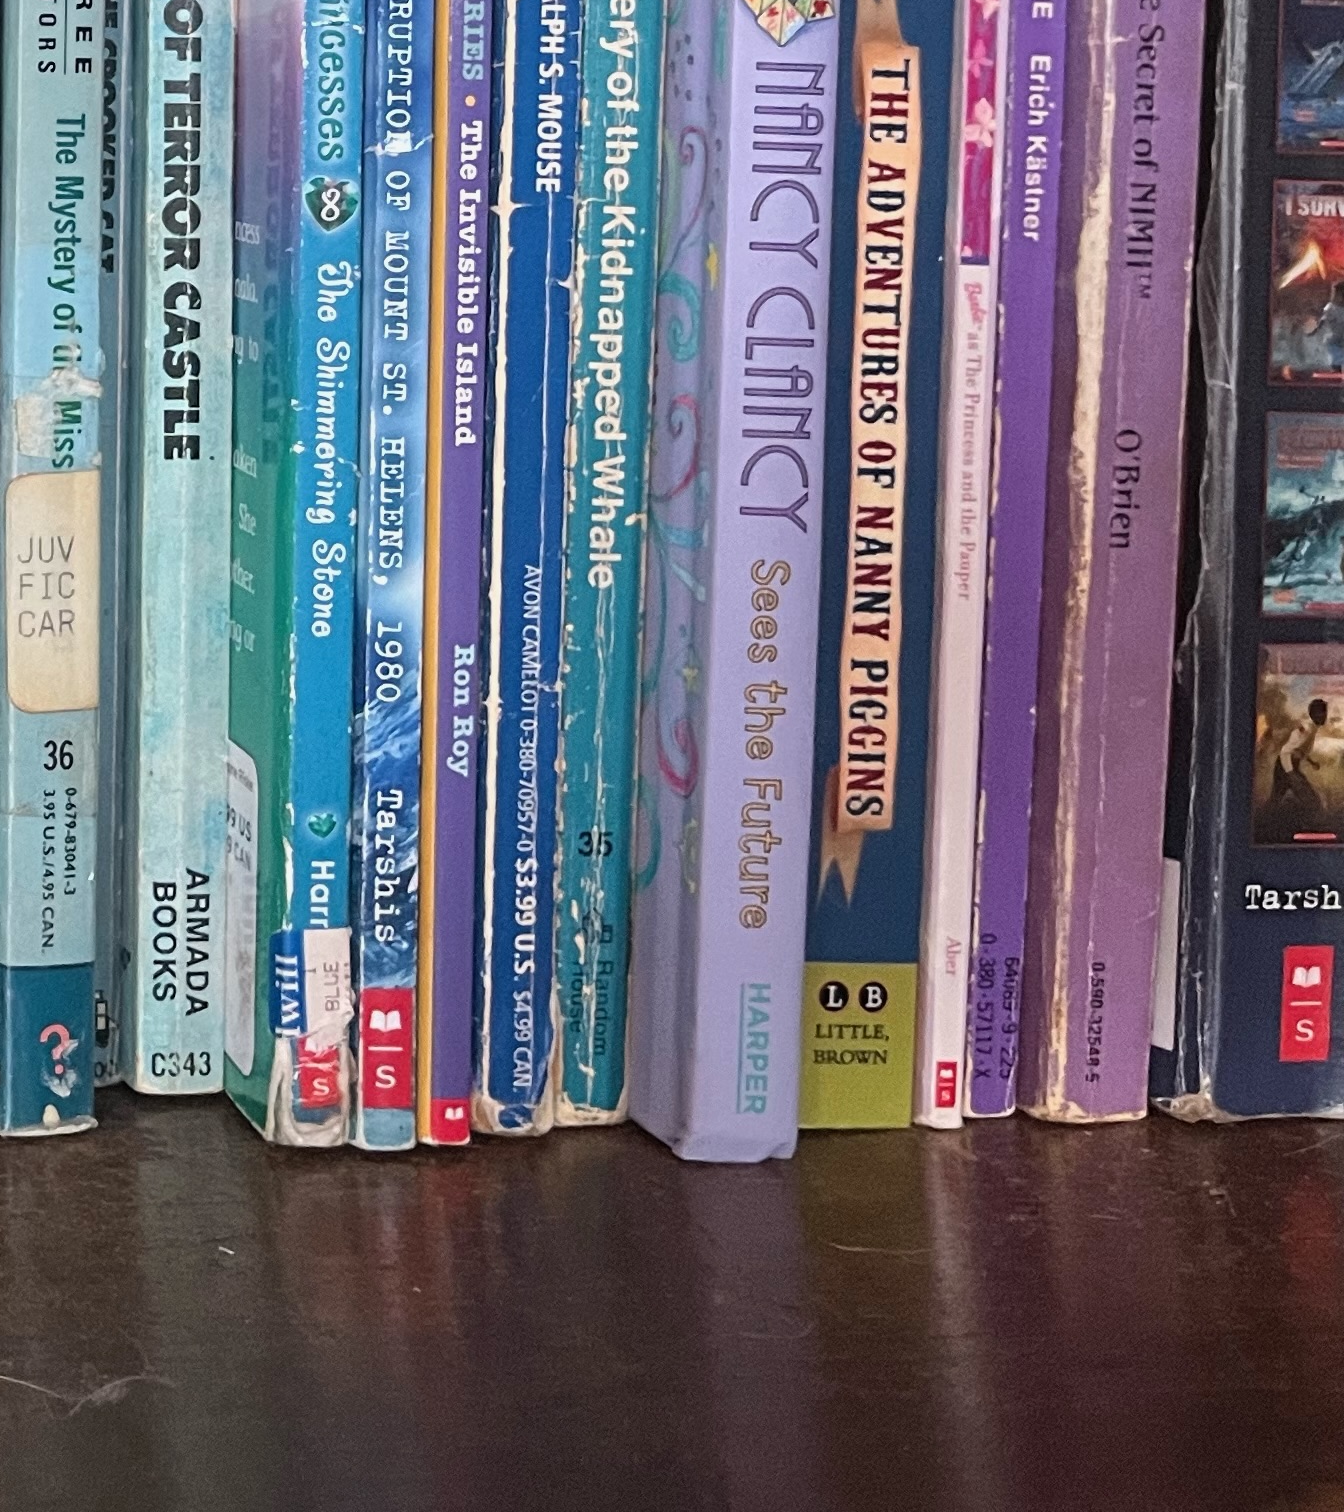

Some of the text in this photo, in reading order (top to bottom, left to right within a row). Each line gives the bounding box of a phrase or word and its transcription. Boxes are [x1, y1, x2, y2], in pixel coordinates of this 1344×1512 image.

[538, 64, 562, 84] S.
[607, 71, 639, 115] of
[1133, 24, 1163, 125] Secret
[536, 95, 562, 193] MOUSE
[604, 126, 637, 191] the
[1022, 55, 1055, 241] Erich Kästner
[1134, 139, 1159, 173] of
[589, 206, 636, 441] Kidnapped
[740, 62, 826, 532] NANCY CLANCY
[845, 59, 910, 817] THE ADVENTURES OF NANNY PIGGINS
[17, 535, 74, 563] JUV
[588, 455, 626, 588] Whale
[18, 611, 75, 637] CAR
[19, 572, 75, 600] FIC
[374, 622, 403, 702] 1980
[448, 645, 474, 776] Ron Roy
[43, 742, 74, 770] 36
[739, 559, 792, 929] Sees the Future
[373, 789, 404, 943] Tarshis
[152, 882, 176, 1001] BOOKS
[186, 869, 209, 1016] ARMADA
[151, 1052, 211, 1076] C343
[744, 983, 772, 1113] HARPER
